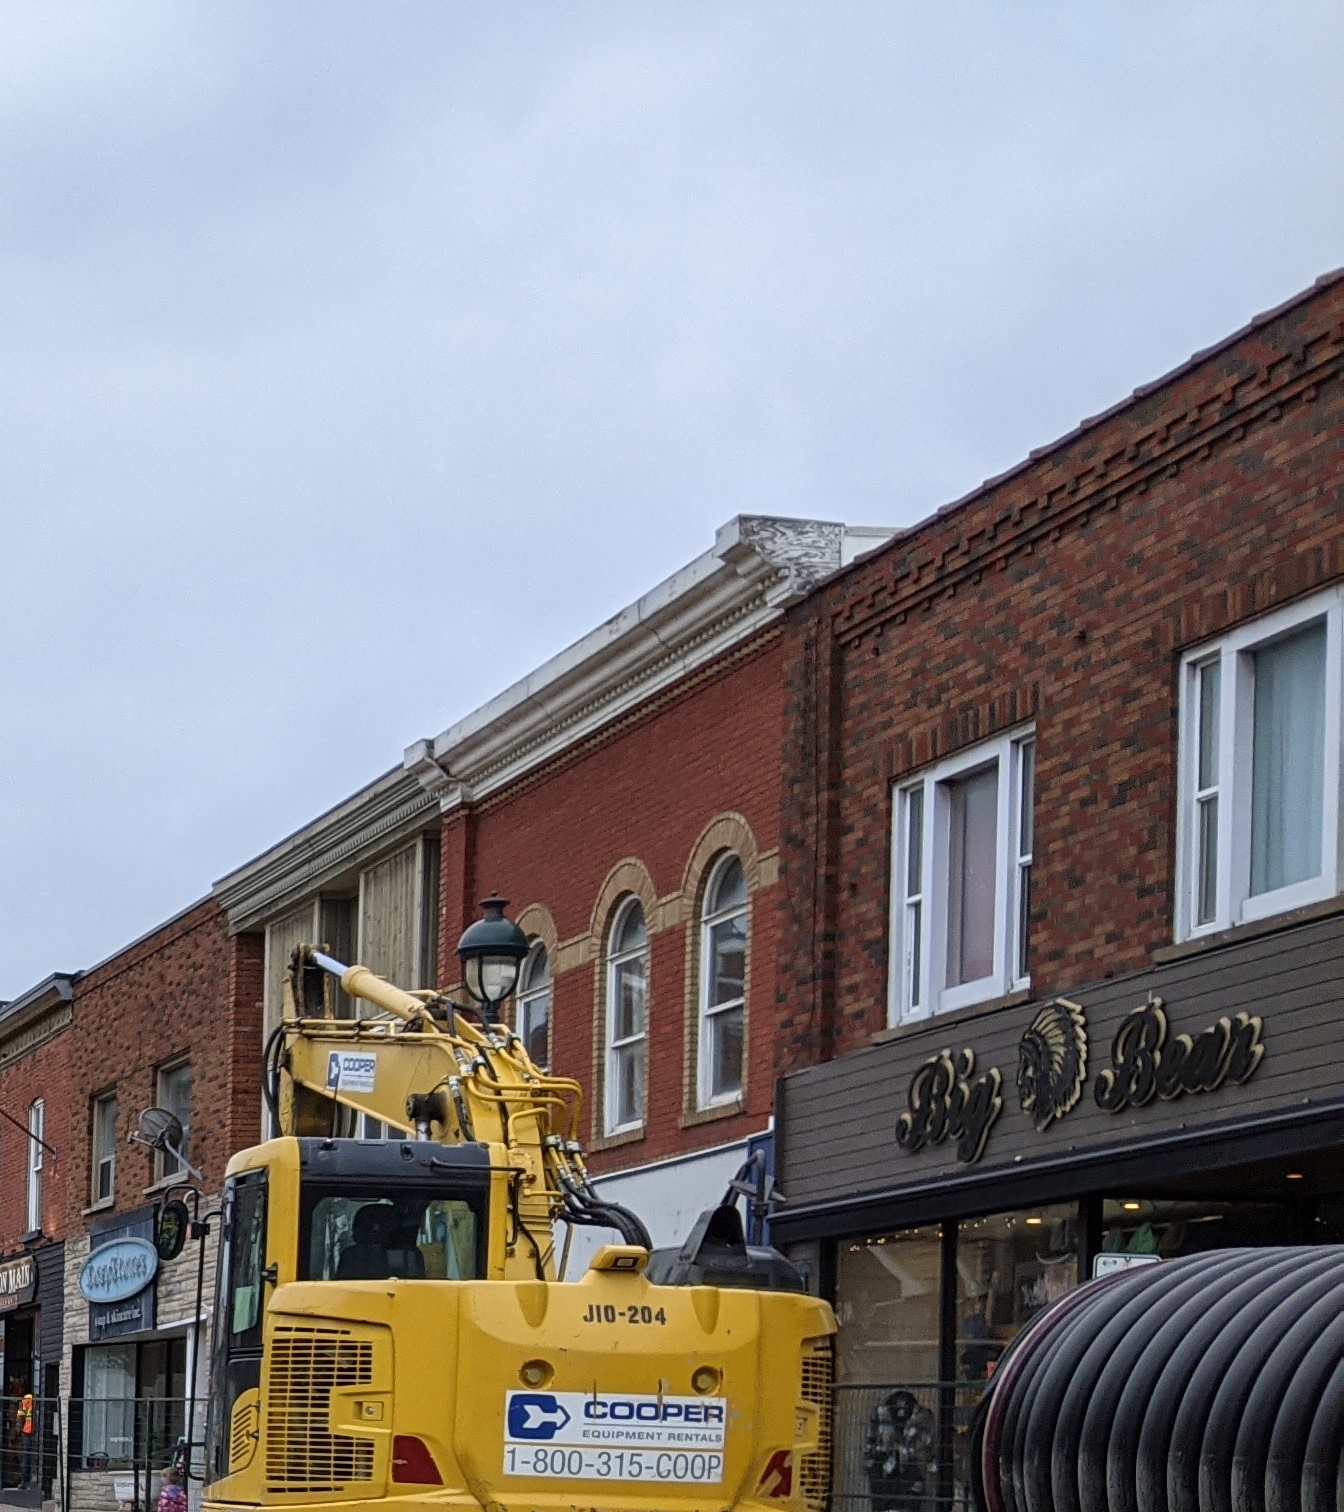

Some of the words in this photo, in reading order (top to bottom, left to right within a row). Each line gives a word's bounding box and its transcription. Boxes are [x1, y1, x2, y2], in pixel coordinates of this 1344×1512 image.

[895, 1047, 1003, 1165] Big
[1094, 994, 1265, 1114] Bear
[8, 1264, 30, 1294] MAIN
[583, 1400, 724, 1424] COOPER
[582, 1429, 662, 1441] EQUIPMENT
[667, 1432, 722, 1443] RENTALS
[506, 1447, 721, 1480] 1-800-315-COOP
